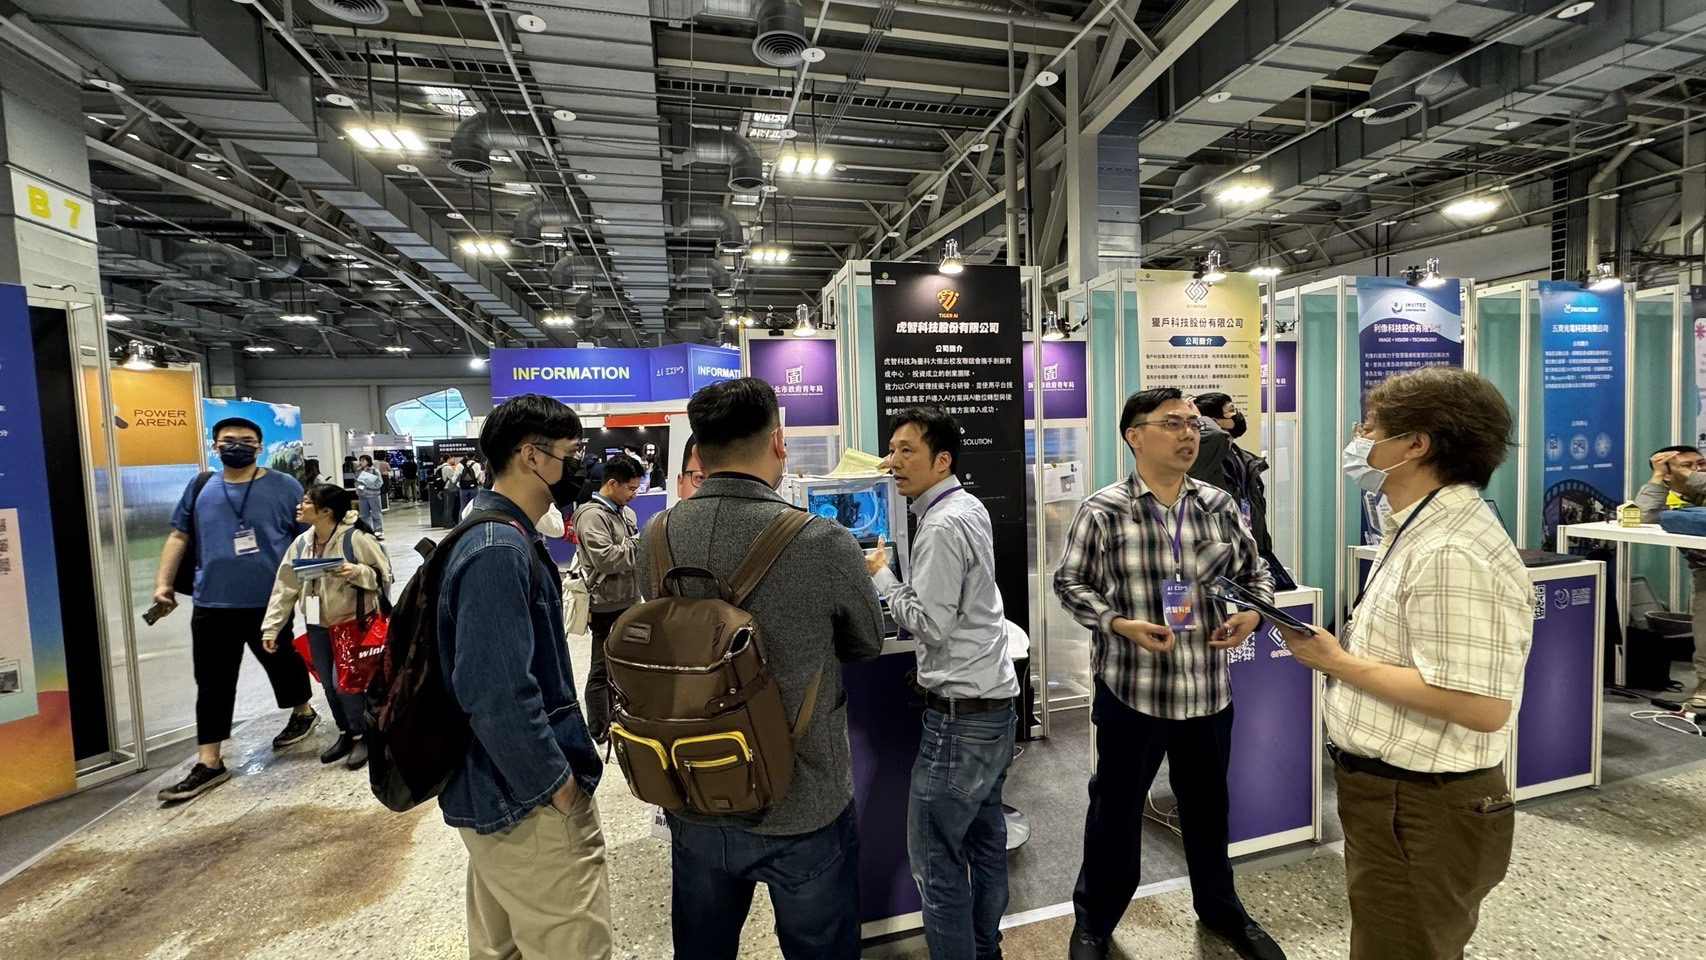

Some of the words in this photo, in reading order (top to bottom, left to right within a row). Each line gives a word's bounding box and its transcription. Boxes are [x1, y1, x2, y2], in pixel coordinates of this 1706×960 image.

[27, 184, 50, 219] B
[63, 199, 81, 229] 7
[896, 321, 1000, 334] 虎智科技股份有限公司
[1185, 337, 1213, 345] 公司簡介
[935, 344, 963, 353] 公司簡介
[513, 366, 630, 381] INFORMATION
[771, 384, 824, 393] 北市政府青年局
[134, 408, 187, 418] POWER
[135, 418, 188, 427] ARENA
[963, 438, 993, 446] SOLUTION
